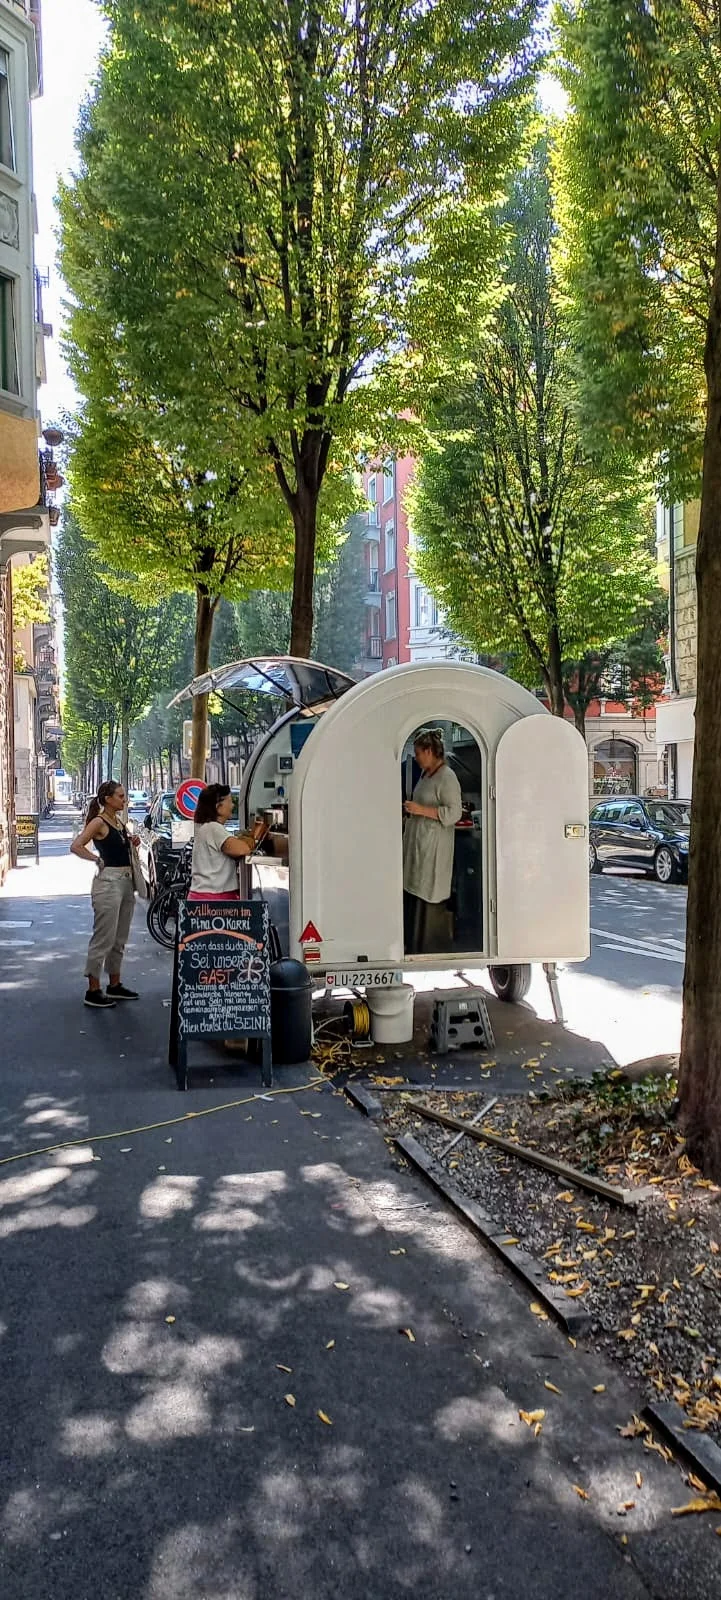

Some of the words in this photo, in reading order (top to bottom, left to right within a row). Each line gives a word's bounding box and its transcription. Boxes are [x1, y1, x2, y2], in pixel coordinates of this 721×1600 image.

[187, 904, 239, 917] Willkommen
[241, 907, 251, 917] im
[191, 918, 210, 930] Pina
[208, 941, 223, 951] dass
[225, 941, 236, 951] du
[236, 941, 244, 951] da
[191, 953, 210, 968] Sei
[199, 969, 235, 984] GAST
